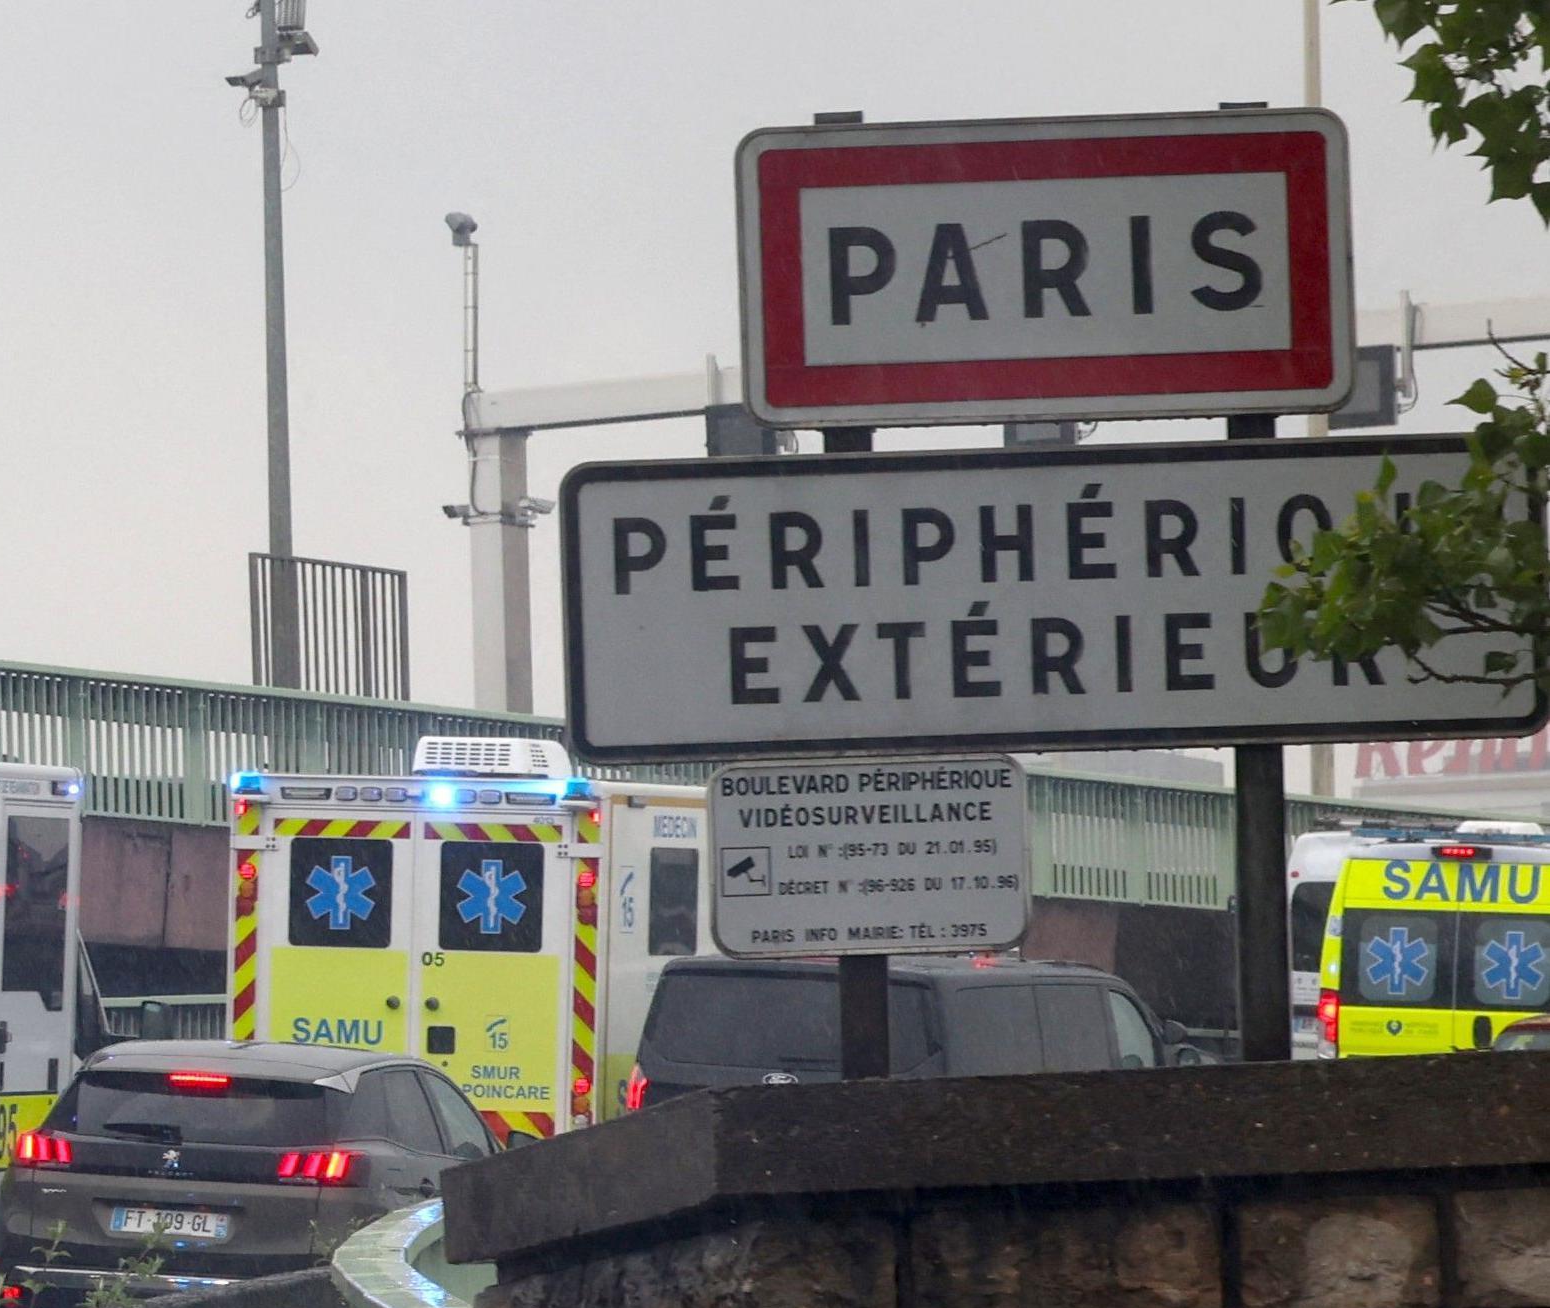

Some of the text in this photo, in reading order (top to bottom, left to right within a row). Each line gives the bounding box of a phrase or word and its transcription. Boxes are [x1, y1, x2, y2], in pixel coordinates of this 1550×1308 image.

[827, 209, 1265, 326] PARIS
[611, 484, 1411, 595] PÉRIPHÉRIQ
[721, 766, 1013, 797] BOULEVARD PÉRIPHÉRIQUE
[738, 801, 993, 828] VIDÉOSURVEILLANCE
[787, 845, 809, 859] LOI
[898, 841, 917, 855] DU
[778, 877, 829, 895] DÉCRET
[924, 877, 943, 891] DU
[1382, 858, 1541, 905] SAMU
[621, 896, 635, 928] 15
[751, 929, 795, 944] PARIS
[804, 927, 838, 942] INFO
[950, 923, 988, 938] 3975
[421, 952, 445, 967] 05
[291, 1017, 384, 1046] SAMU
[489, 1032, 510, 1050] 15
[470, 1065, 521, 1080] SMUR
[464, 1084, 550, 1101] POINCARE
